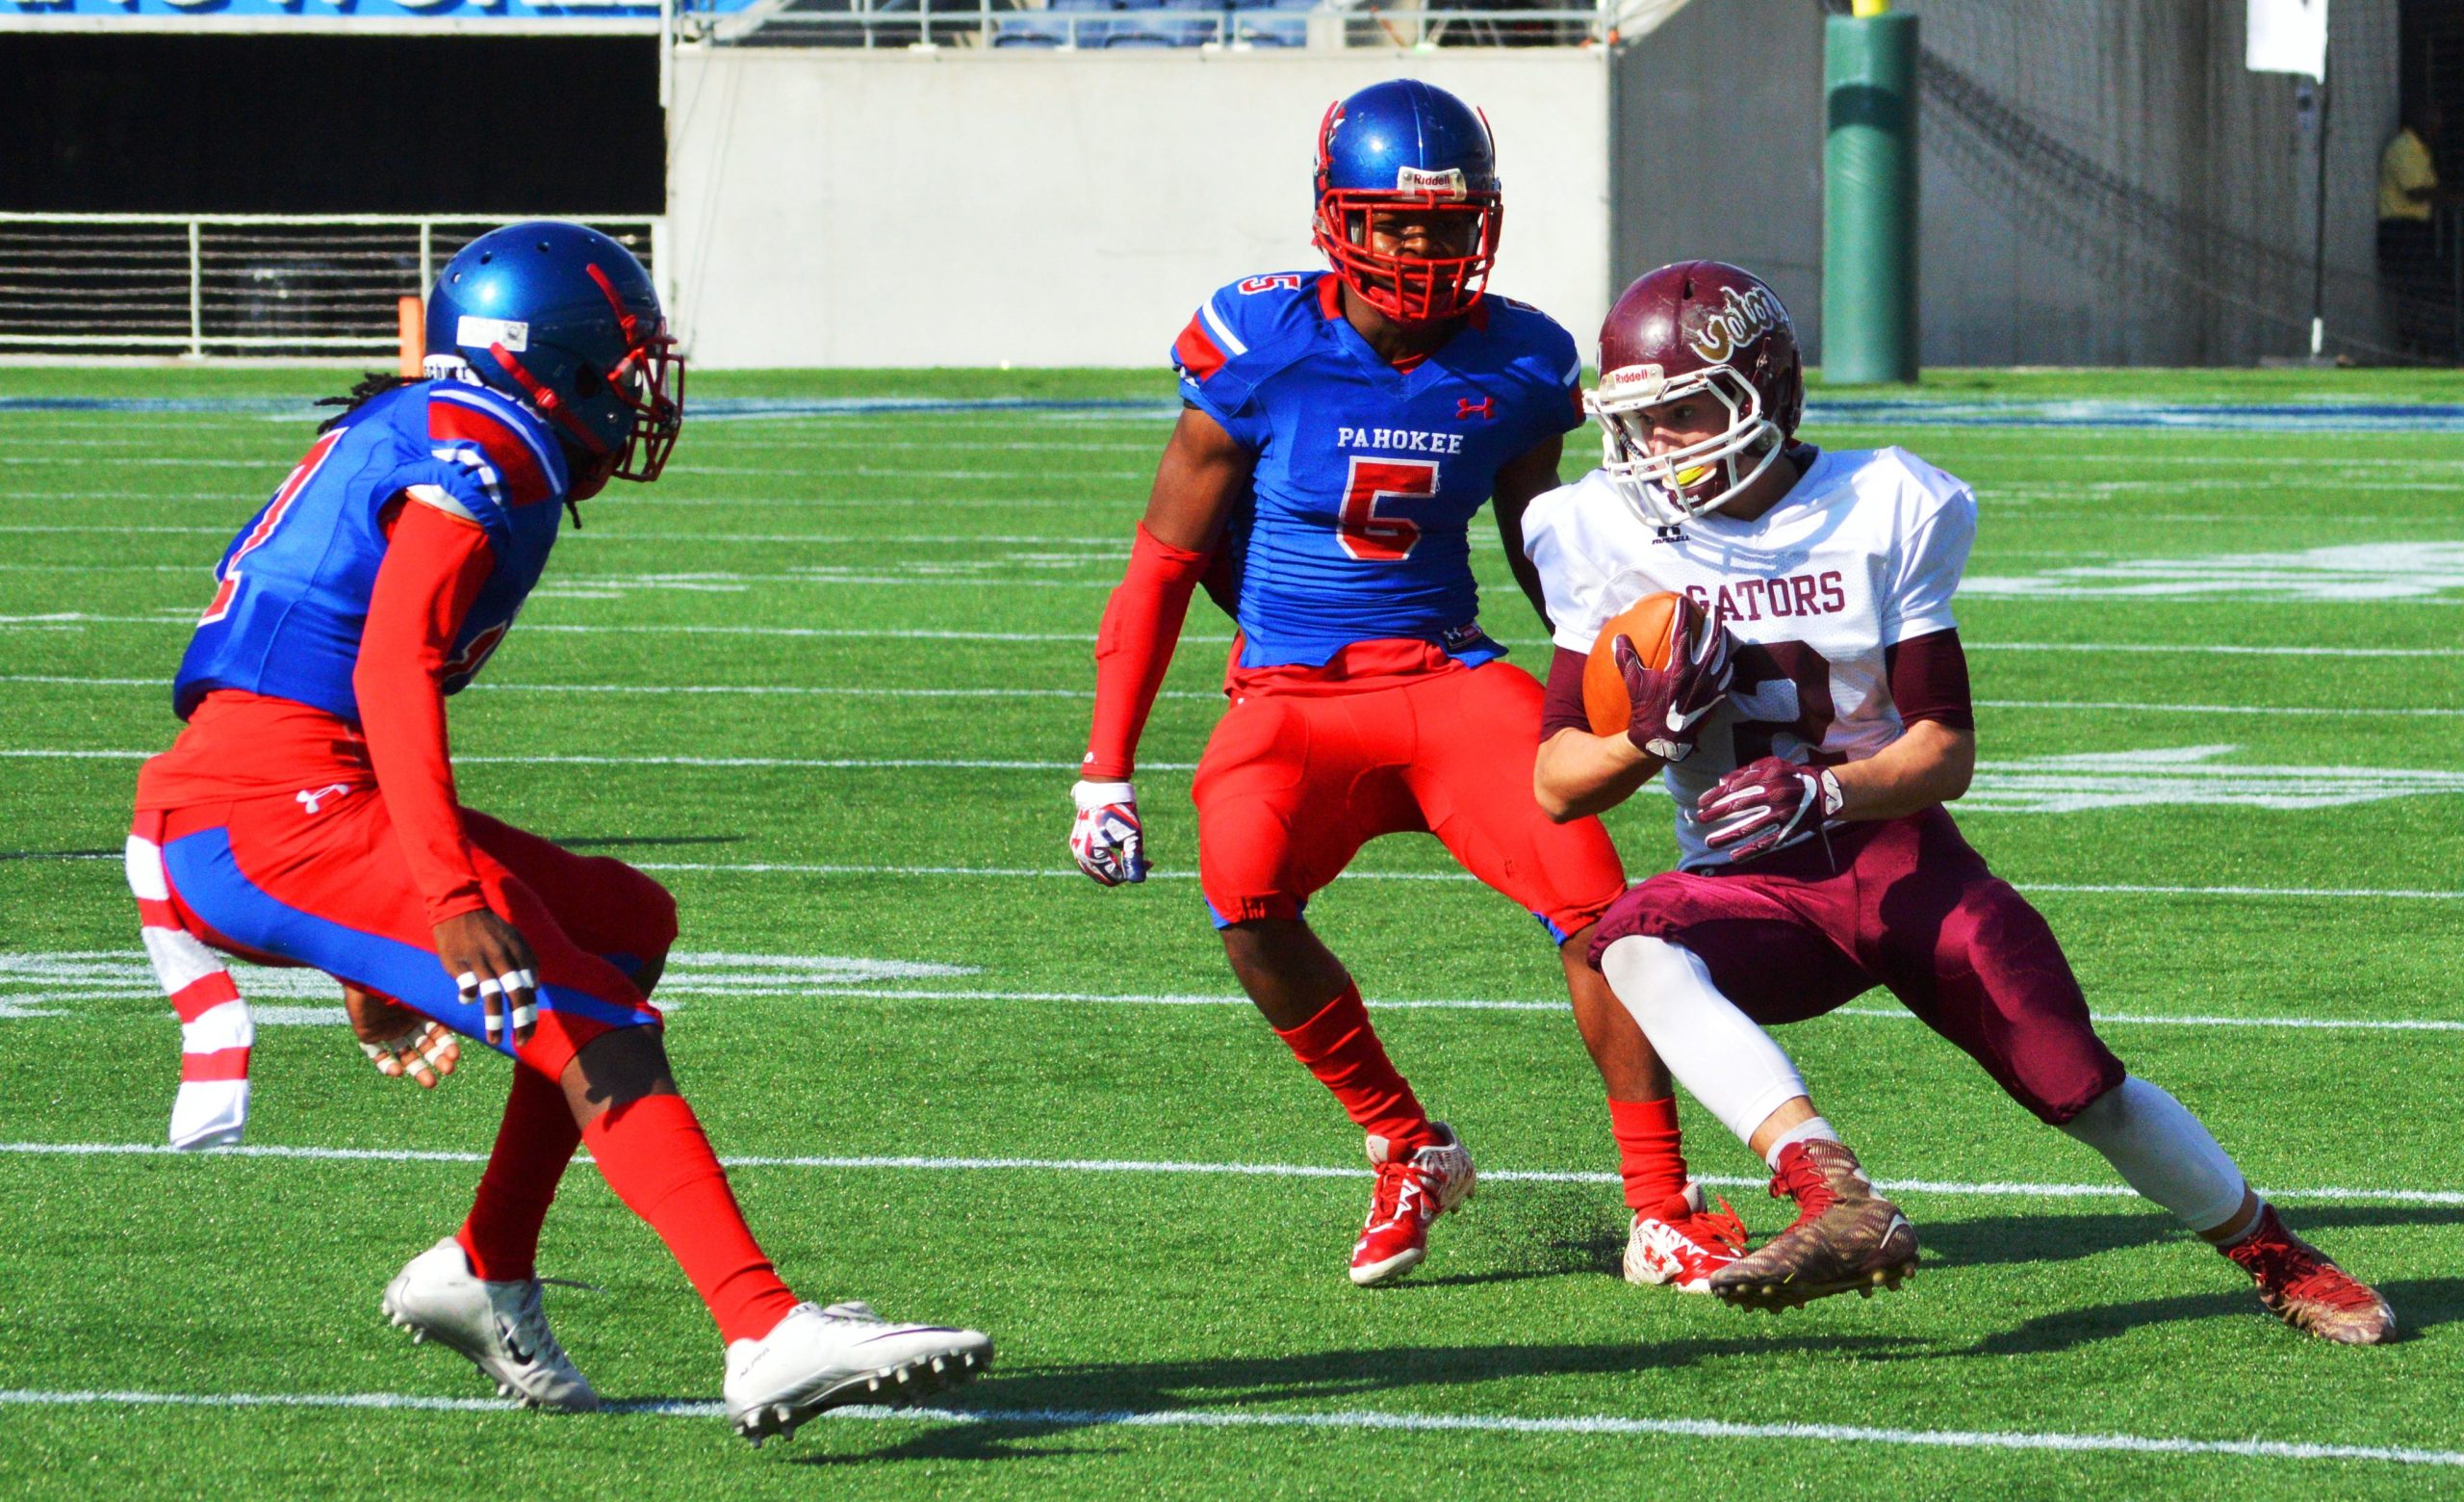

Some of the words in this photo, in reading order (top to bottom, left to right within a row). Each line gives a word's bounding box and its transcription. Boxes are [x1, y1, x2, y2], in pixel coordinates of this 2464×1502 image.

[1414, 173, 1450, 186] Riddell
[1238, 274, 1300, 296] 5
[1615, 369, 1649, 385] Riddell
[1337, 427, 1464, 454] PAHOKEE
[1336, 455, 1440, 561] 5
[1652, 534, 1691, 545] RUSSELL
[1685, 570, 1846, 621] GATORS
